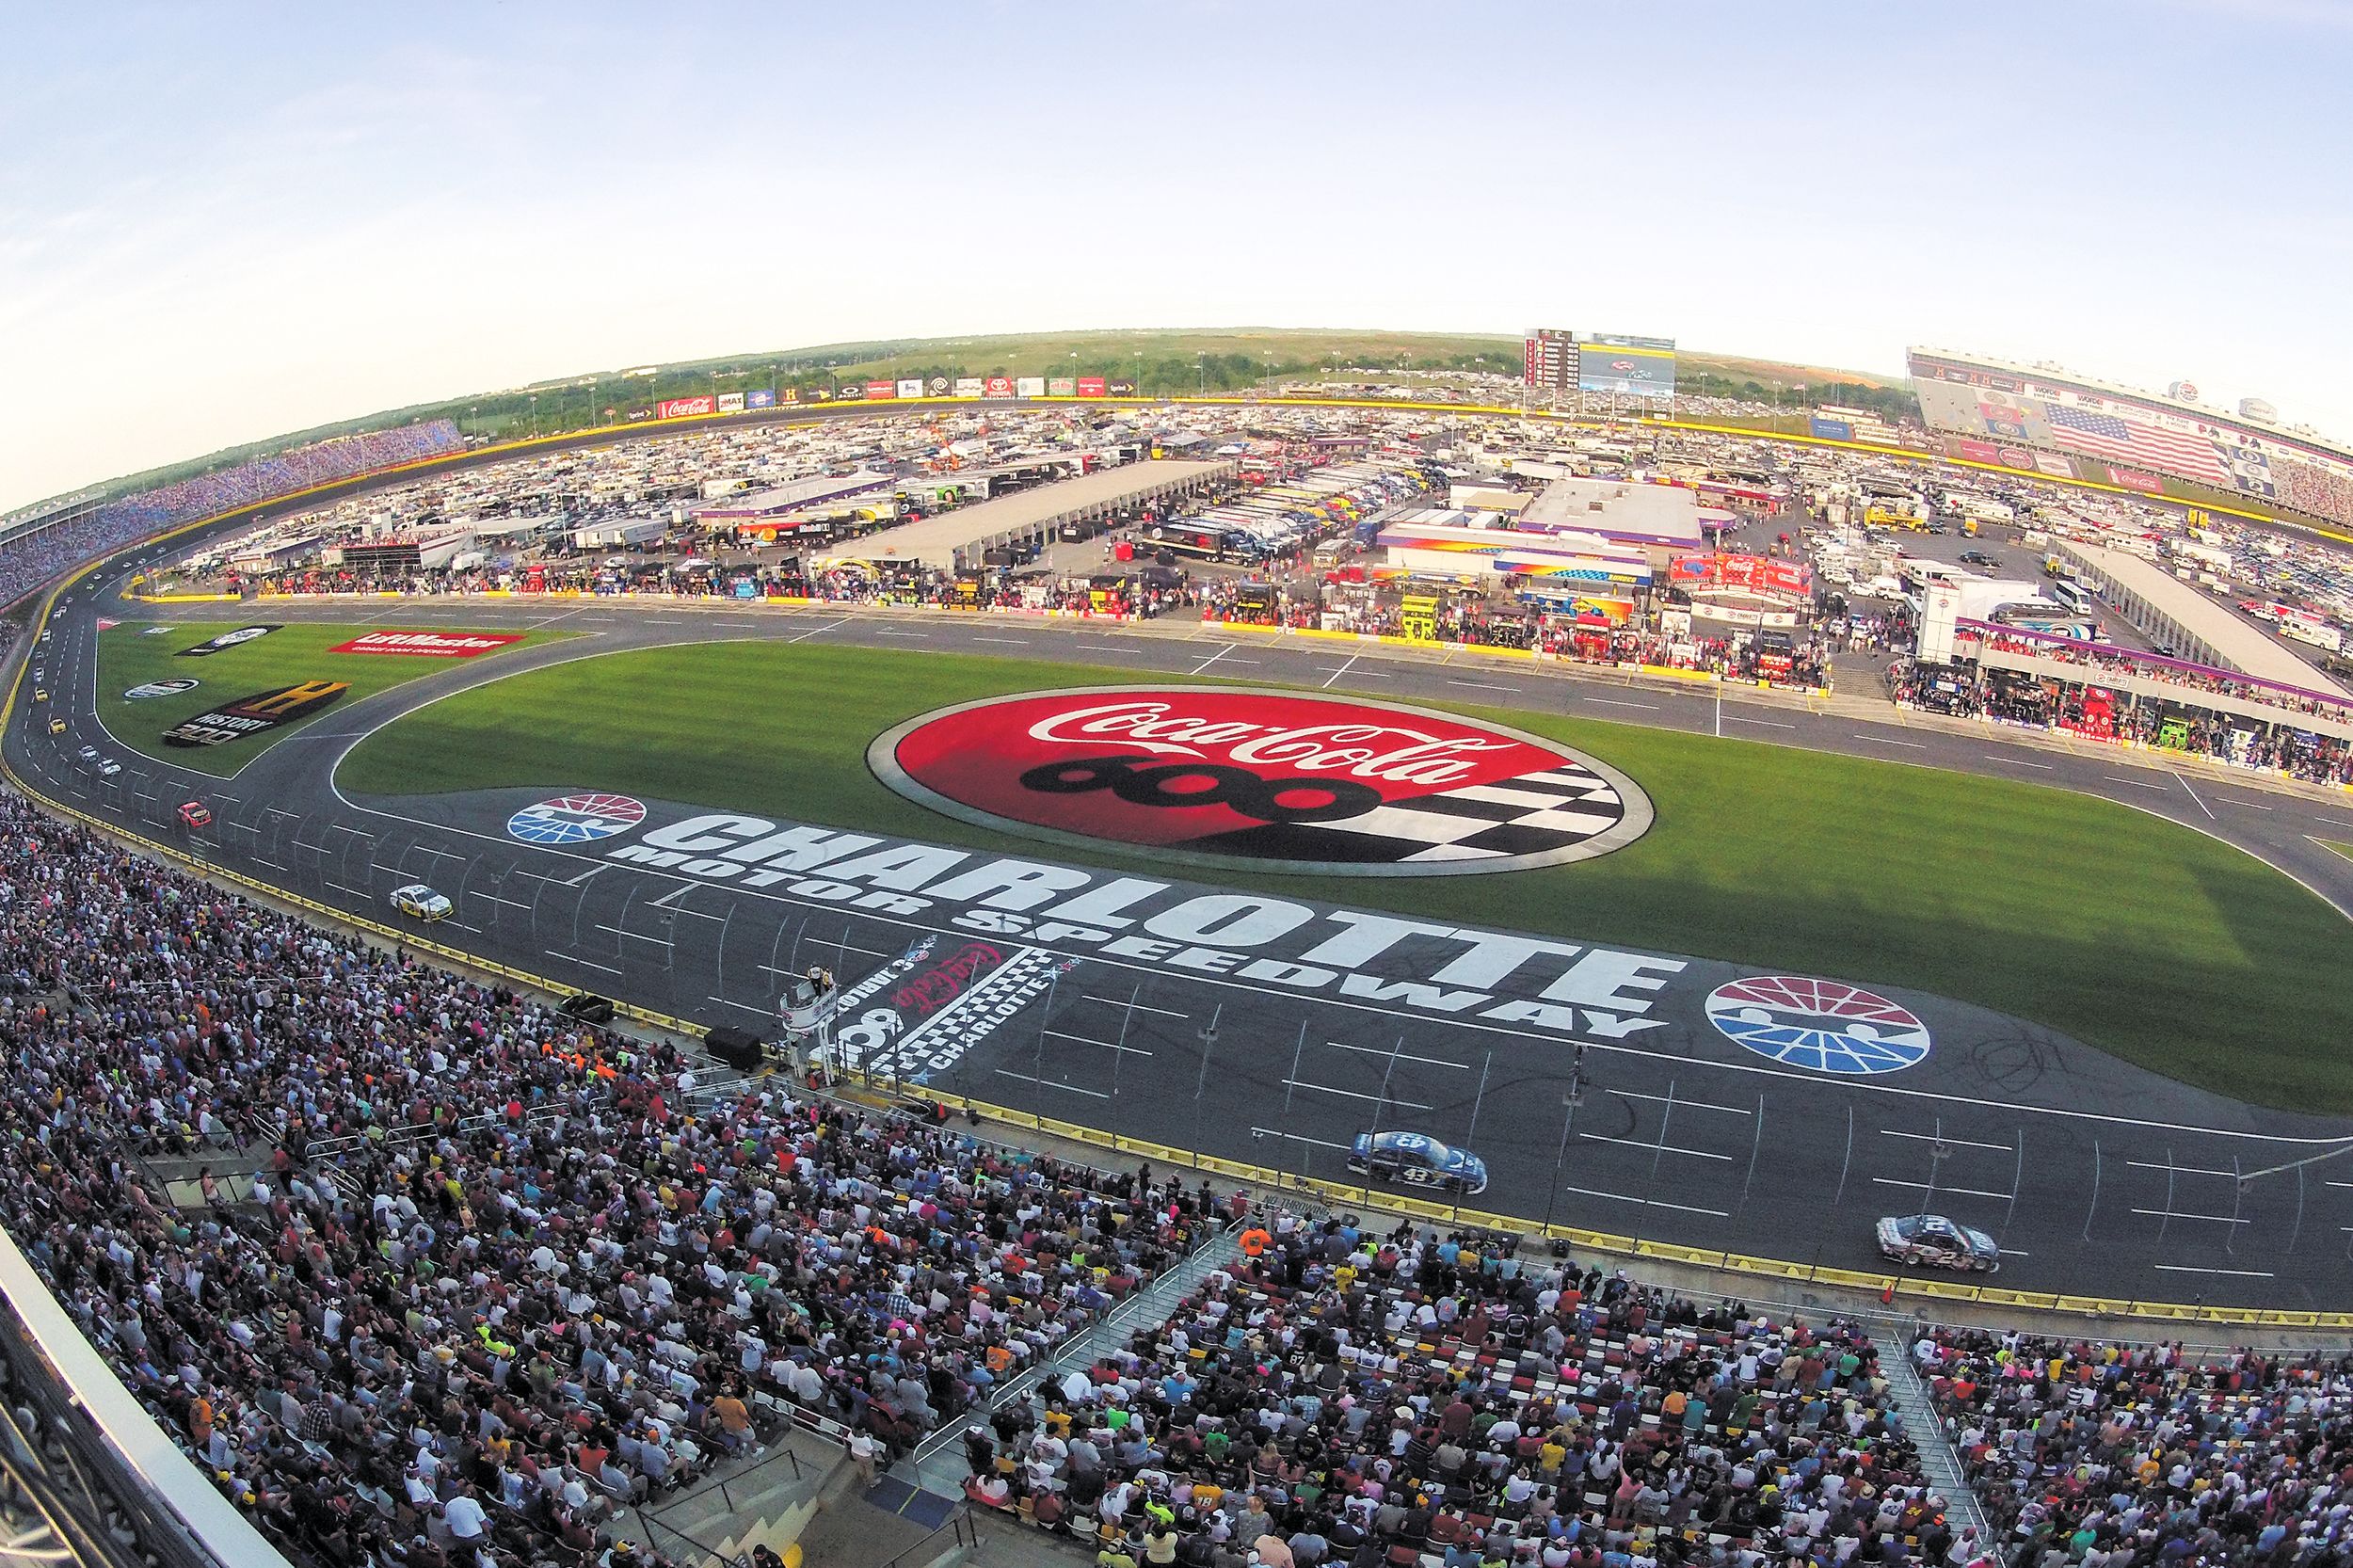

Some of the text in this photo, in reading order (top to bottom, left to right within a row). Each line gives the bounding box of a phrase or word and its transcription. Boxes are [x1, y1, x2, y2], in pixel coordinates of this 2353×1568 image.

[667, 398, 712, 418] Coca-Cola
[2121, 473, 2156, 489] Coca-Cola
[355, 632, 505, 648] LiftMaster
[194, 712, 273, 731] HISTORY
[1028, 702, 1521, 785] Coca-Cola
[1019, 755, 1383, 824] 600
[642, 814, 1689, 1013] CHARLOTTE
[604, 845, 1671, 1039] MOTOR SPEEDWAY
[927, 977, 1052, 1070] CHARLOTTE
[1403, 1168, 1429, 1182] 43
[1263, 1194, 1331, 1216] NO THROWING
[1289, 1354, 1305, 1366] 87
[1197, 1496, 1213, 1507] 18
